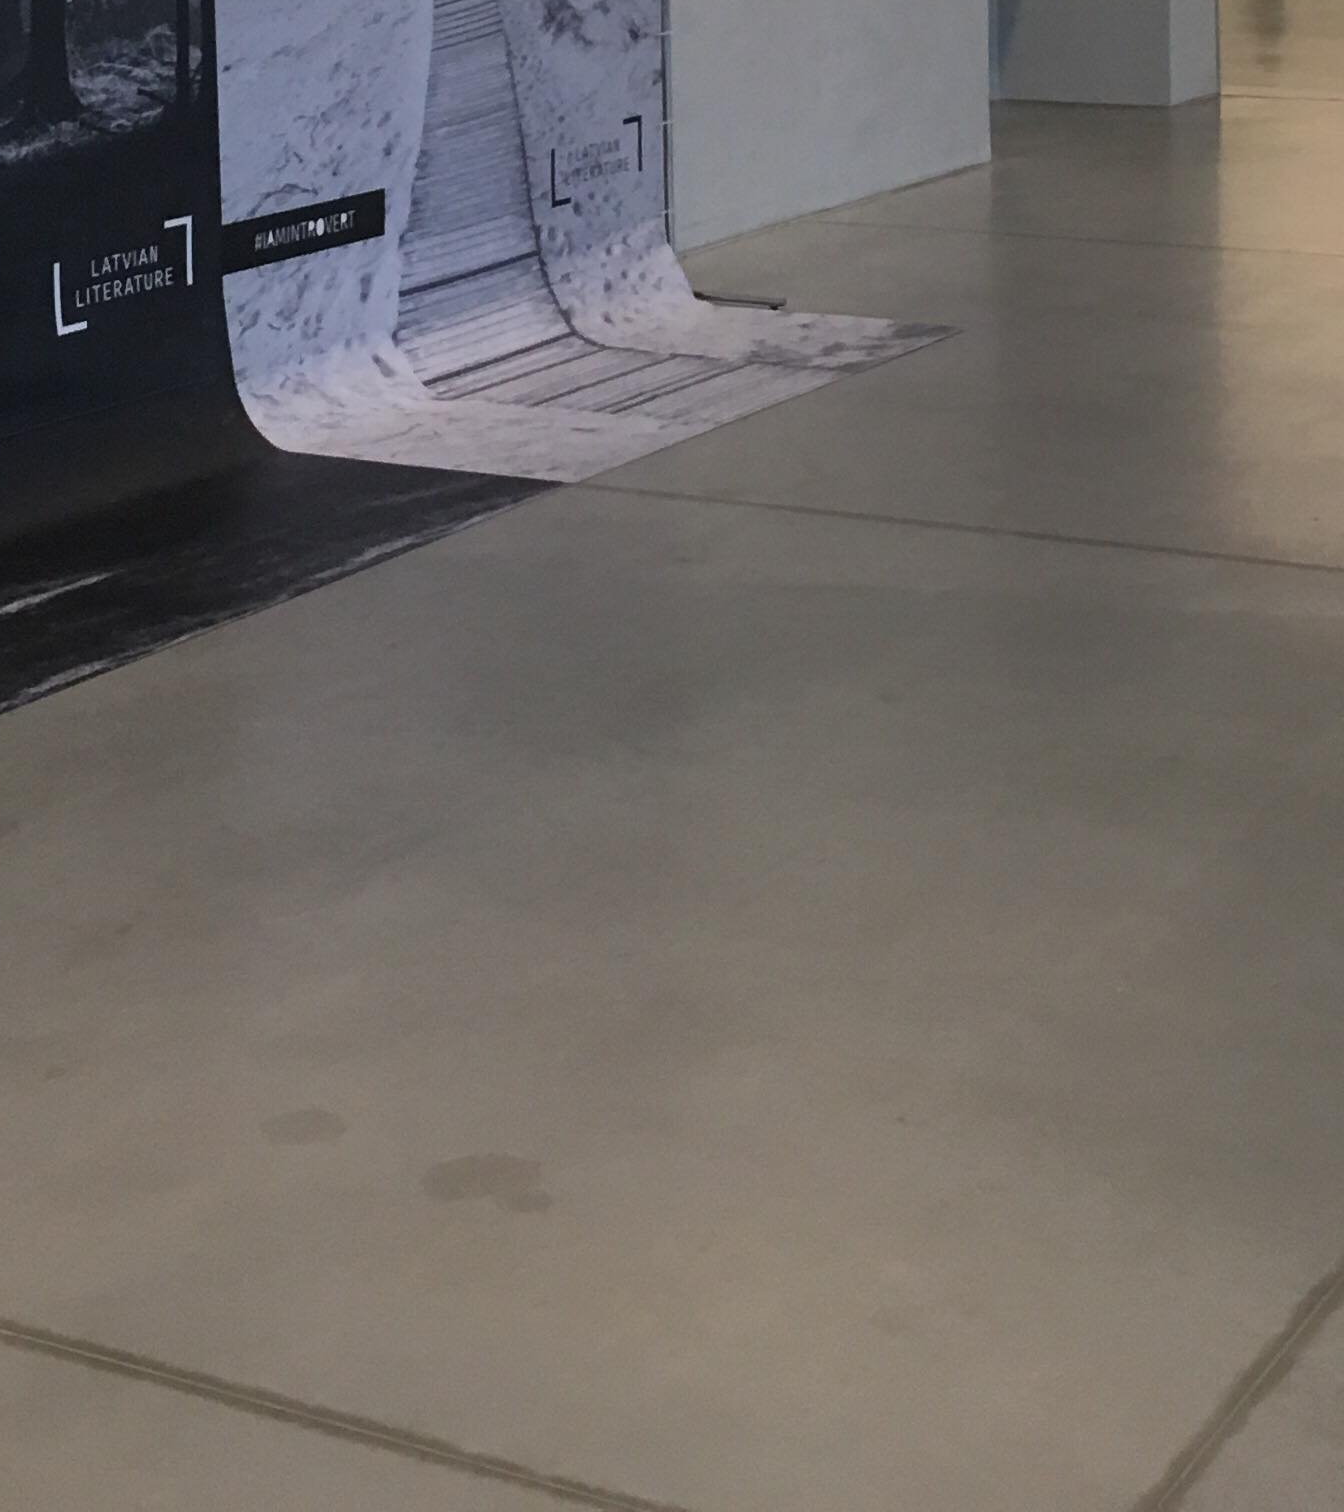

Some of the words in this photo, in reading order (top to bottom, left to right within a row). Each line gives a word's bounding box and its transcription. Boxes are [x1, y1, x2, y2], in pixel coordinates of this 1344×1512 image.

[253, 209, 357, 253] #IAMINTROVERT
[90, 245, 158, 277] LATVIAN
[75, 267, 175, 308] LITERATURE
